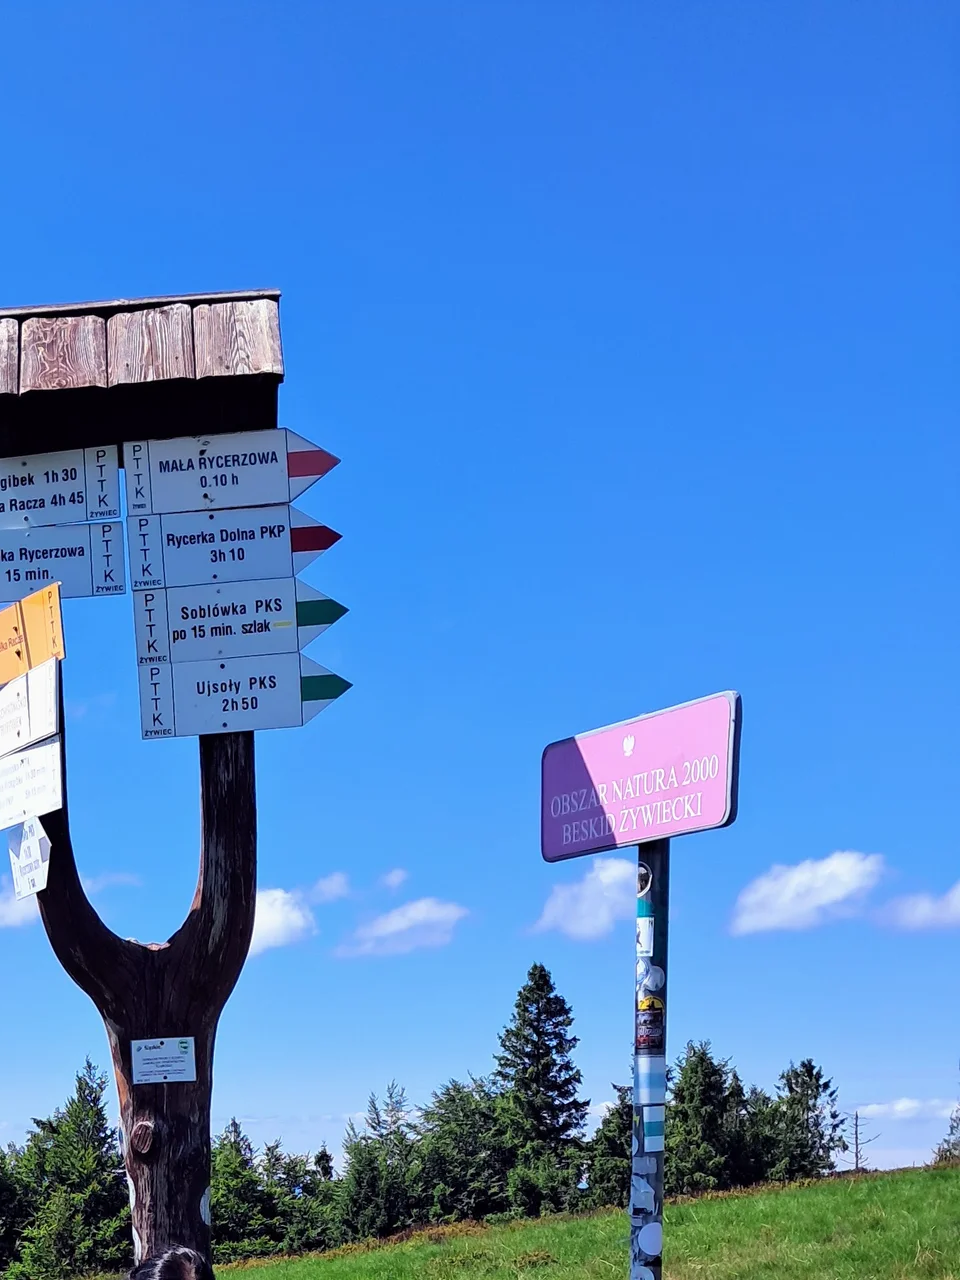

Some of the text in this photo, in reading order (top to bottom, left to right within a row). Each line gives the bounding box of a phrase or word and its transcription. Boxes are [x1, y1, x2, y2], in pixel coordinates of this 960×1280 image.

[132, 445, 144, 499] PTTK
[159, 451, 278, 473] MAŁA RYCERZOWA
[96, 450, 108, 508] PTTK
[200, 473, 238, 488] 0.10 h
[10, 497, 46, 512] Racza
[90, 508, 118, 518] ŻYWIEC
[138, 518, 152, 577] PTTK
[167, 525, 286, 548] Rycerka Dolna PKP
[19, 546, 85, 562] Rycerzowa
[102, 525, 114, 582] PTTK
[5, 568, 54, 582] 15 min.
[134, 579, 162, 588] ŻYWIEC
[96, 584, 124, 592] ŻYWIEC
[181, 598, 283, 620] Soblówka PKS
[144, 594, 158, 654] PTTK
[172, 620, 271, 644] po 15 min. szlak
[140, 655, 168, 664] ŻYWIEC
[196, 676, 277, 696] Ujsoły PKS
[150, 668, 164, 727] PTTK
[144, 728, 172, 737] ŻYWIEC
[550, 754, 719, 818] OBSZAR NATURA 2000
[562, 792, 703, 846] BESKID ŻYWIECKI
